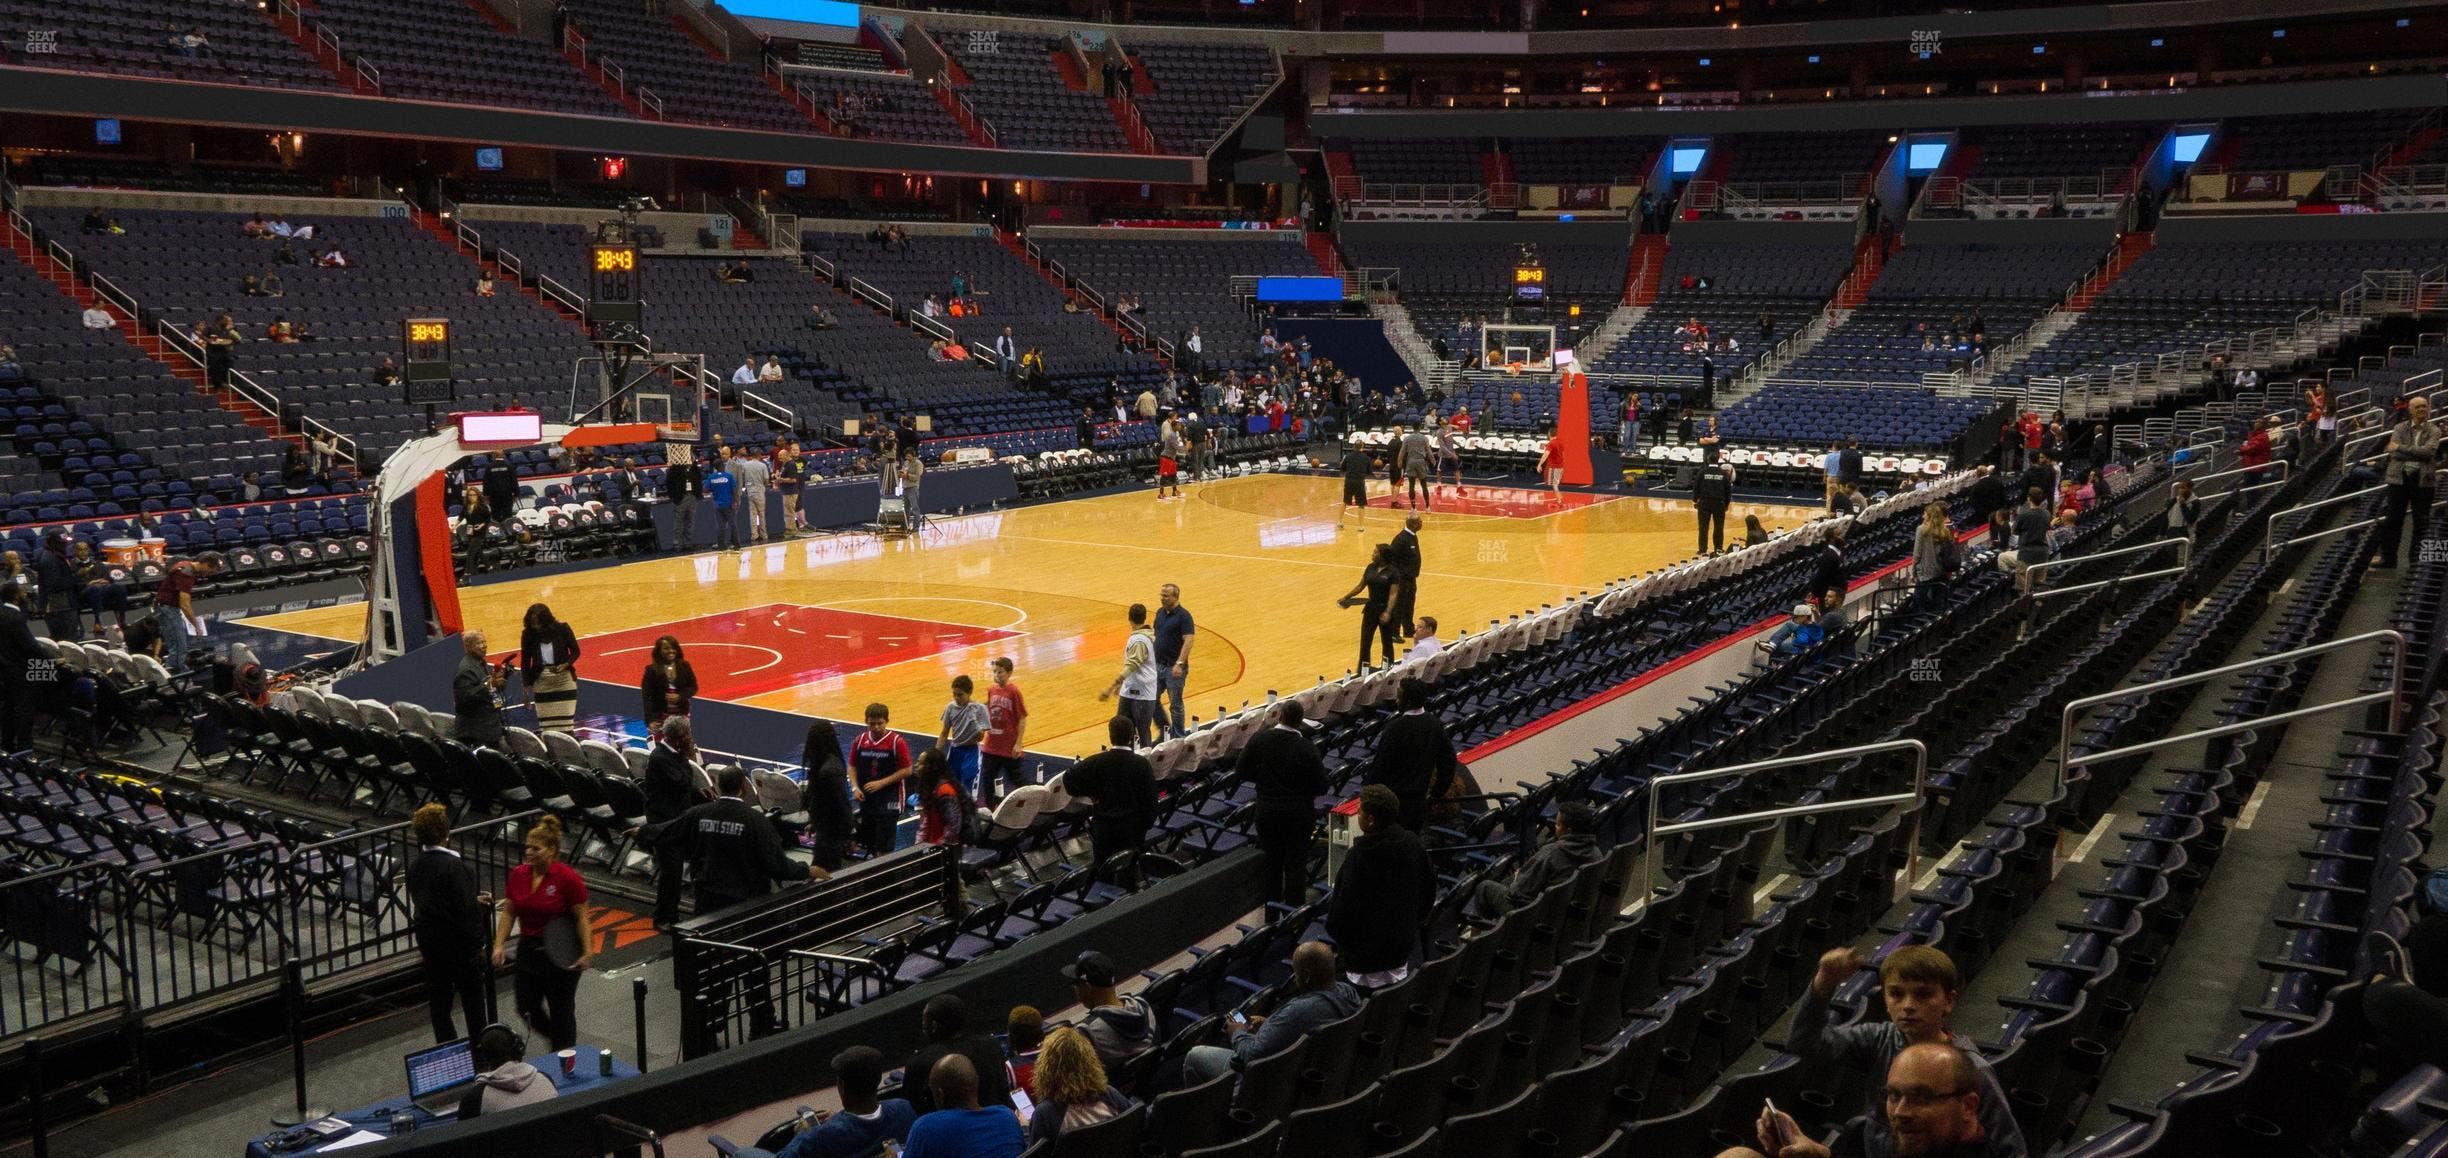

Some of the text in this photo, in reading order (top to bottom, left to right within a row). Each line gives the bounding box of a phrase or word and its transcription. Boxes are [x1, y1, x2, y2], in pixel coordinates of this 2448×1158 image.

[383, 206, 405, 218] 100
[715, 219, 729, 229] 121
[975, 227, 990, 237] 120
[596, 250, 632, 269] 38:43
[1517, 270, 1542, 281] 38:43
[412, 324, 443, 341] 38:43
[720, 821, 745, 836] STAFF
